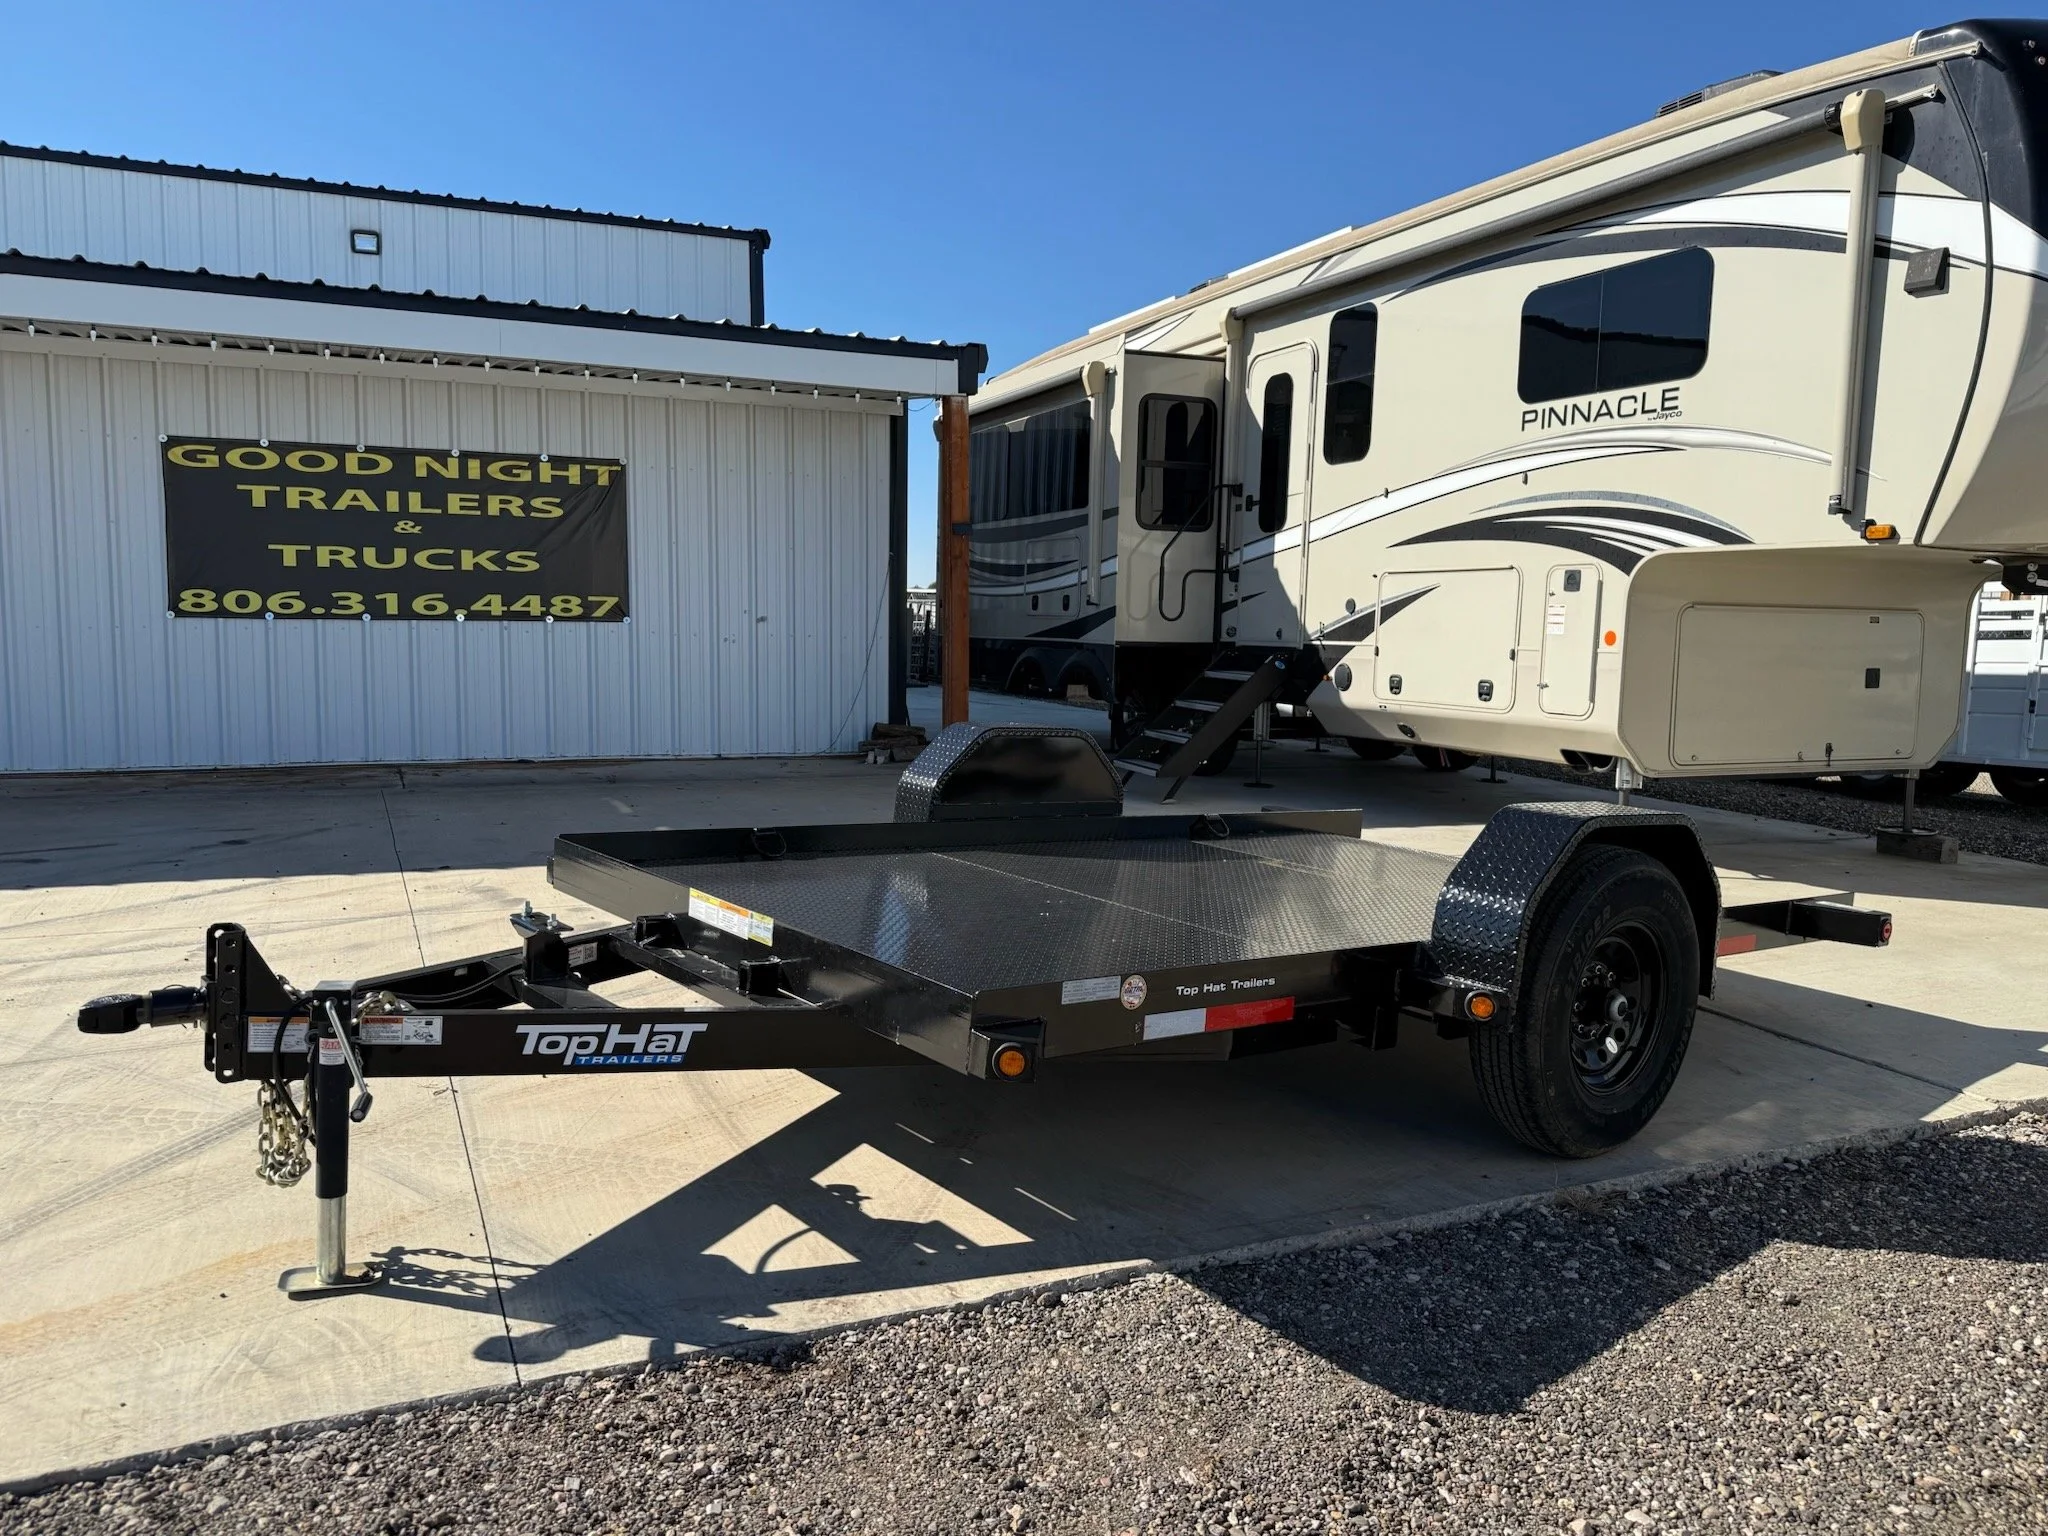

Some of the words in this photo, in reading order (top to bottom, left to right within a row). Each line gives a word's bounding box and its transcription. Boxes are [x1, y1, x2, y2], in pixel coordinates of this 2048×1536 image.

[1521, 387, 1680, 432] PINNACLE
[1653, 410, 1683, 421] Jayco
[167, 444, 394, 476] GOOD
[415, 454, 623, 487] NIGHT
[236, 483, 565, 519] TRAILERS
[393, 520, 423, 535] &
[268, 544, 541, 573] TRUCKS
[177, 588, 620, 618] 806.316.4487
[1176, 985, 1199, 997] Top
[1203, 983, 1227, 993] Hat
[1230, 976, 1276, 990] Trailers
[578, 1054, 683, 1064] TRAILERS
